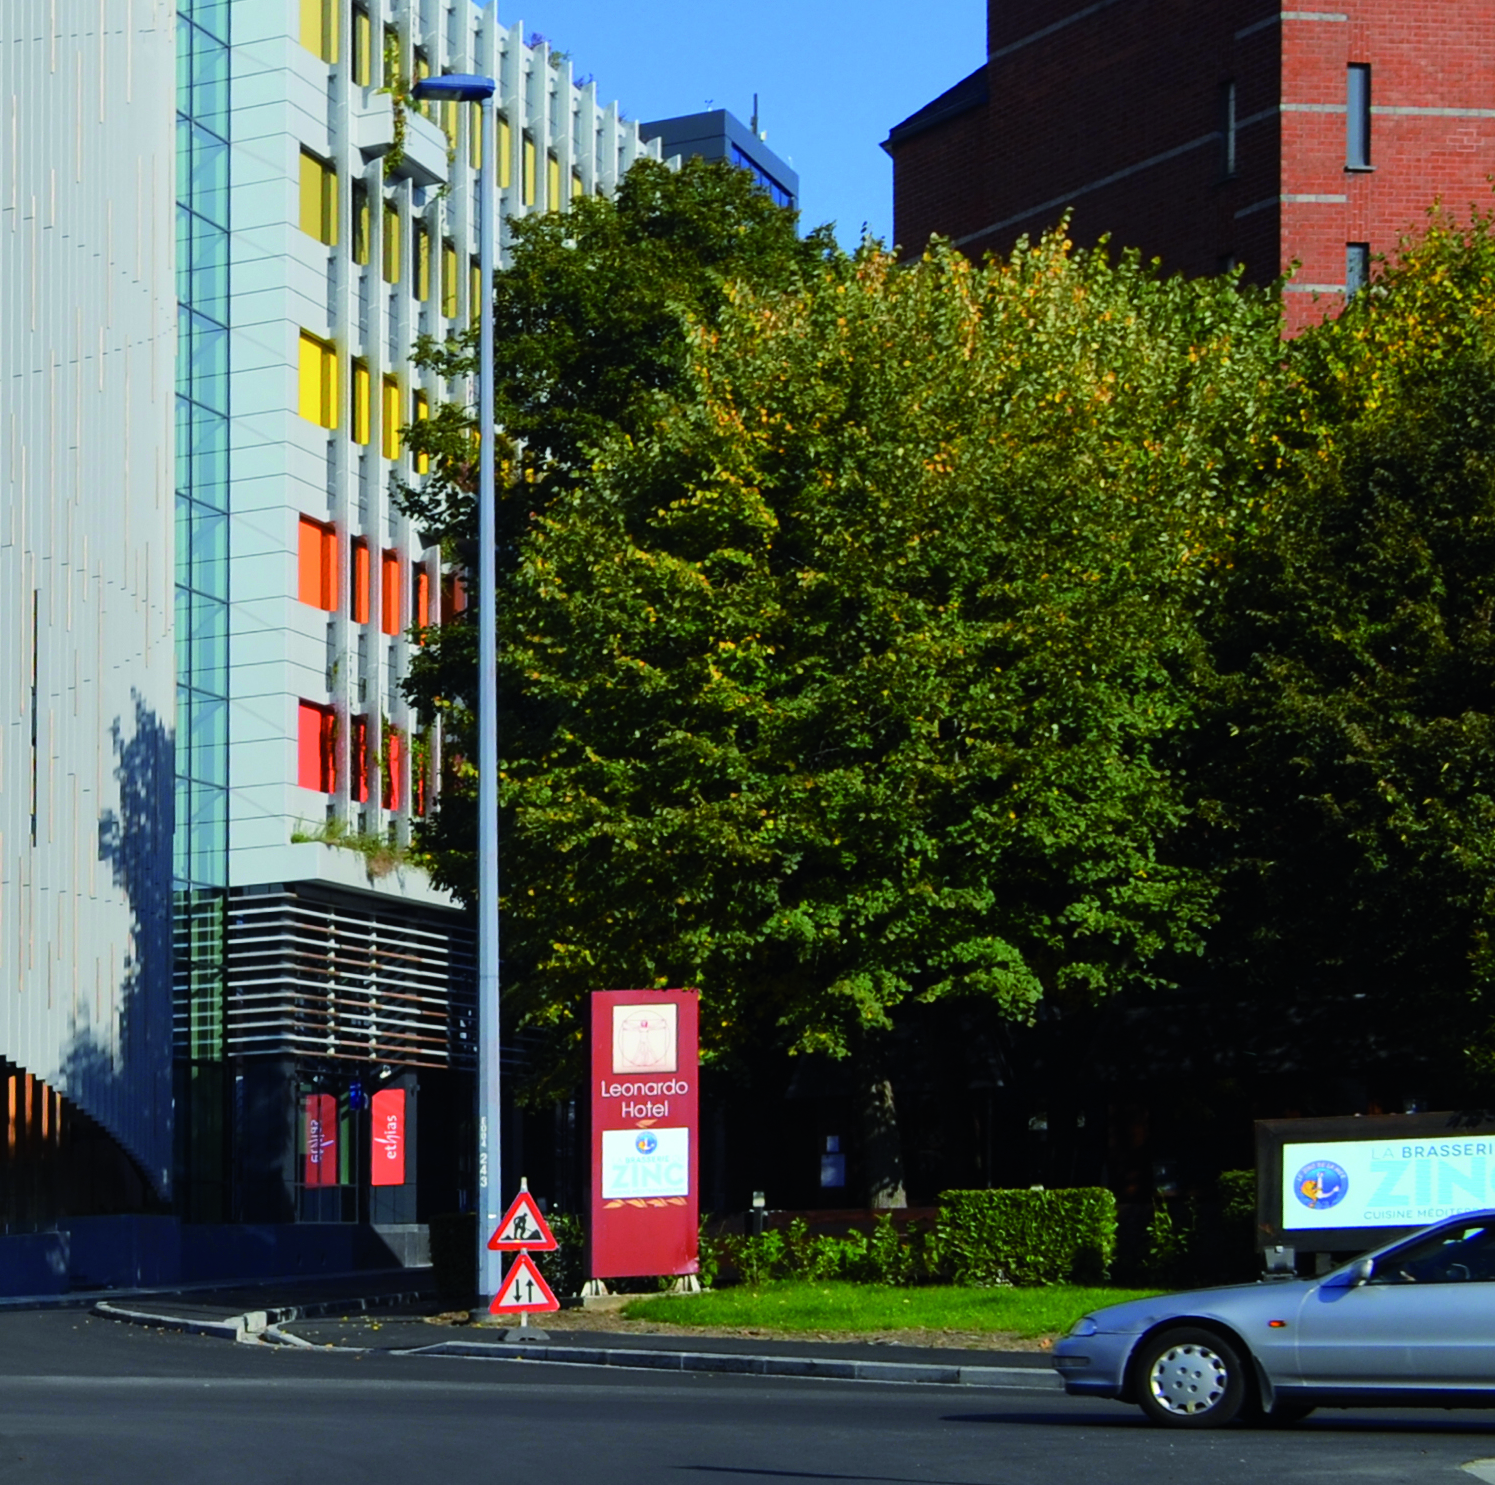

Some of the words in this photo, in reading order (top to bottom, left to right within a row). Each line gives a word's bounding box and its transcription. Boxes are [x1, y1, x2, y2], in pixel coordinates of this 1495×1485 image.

[601, 1078, 689, 1098] Leonardo
[621, 1100, 669, 1118] Hotel
[374, 1114, 401, 1159] ethias
[625, 1155, 669, 1164] BRASSERIE
[1371, 1147, 1395, 1160] LA
[1402, 1143, 1493, 1159] BRASSERI
[479, 1153, 488, 1188] 243
[611, 1162, 685, 1189] ZINC
[1366, 1156, 1495, 1208] ZIN
[1363, 1209, 1413, 1220] CUISINE
